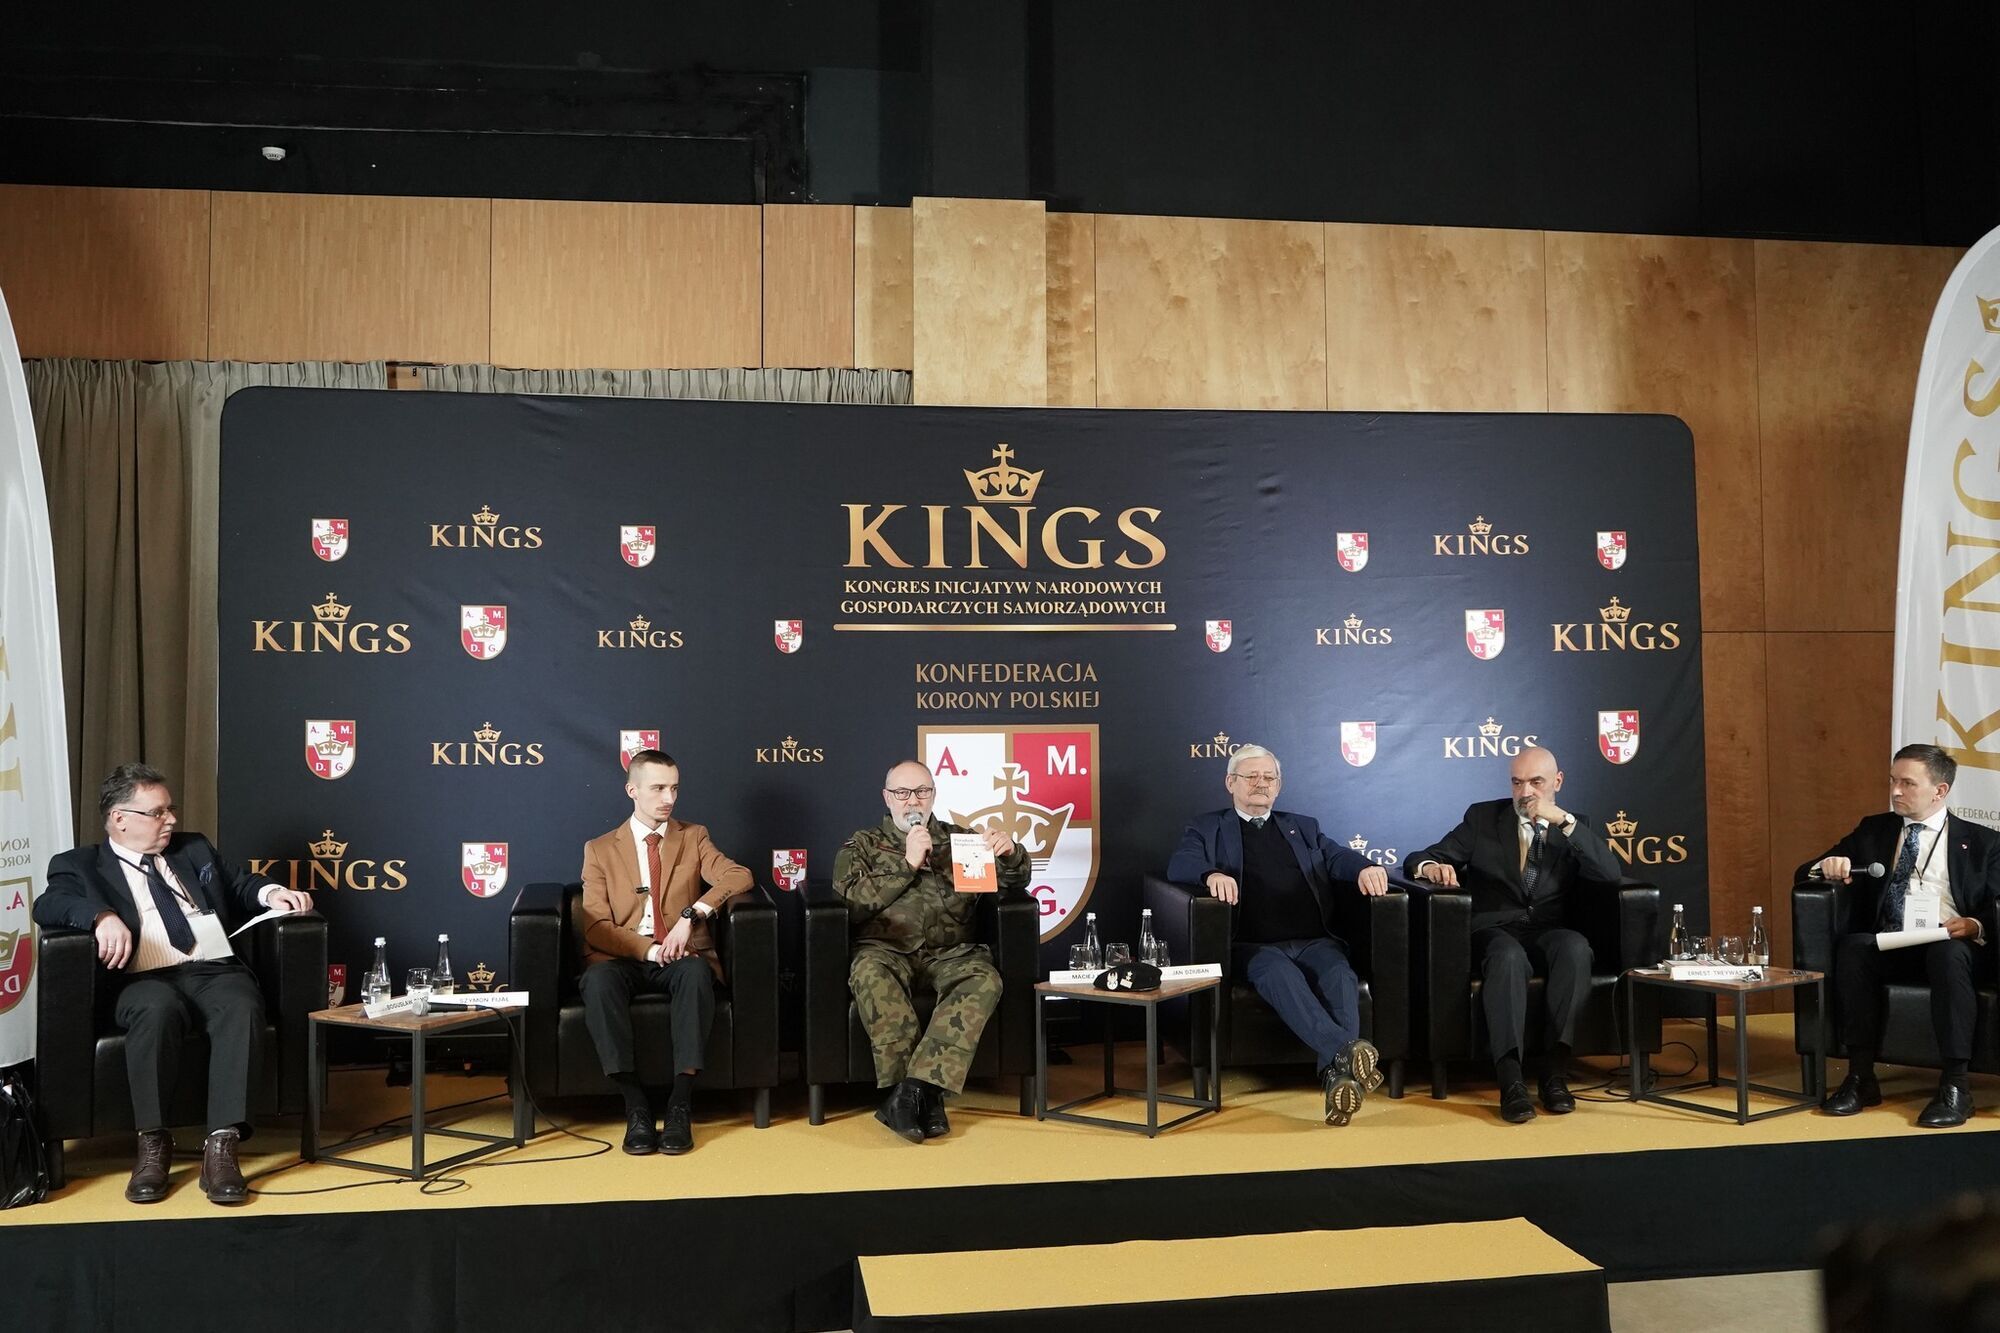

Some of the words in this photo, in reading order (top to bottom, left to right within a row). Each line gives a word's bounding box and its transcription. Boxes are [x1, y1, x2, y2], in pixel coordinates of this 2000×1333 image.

[429, 524, 543, 549] KINGS
[840, 503, 1167, 569] KINGS
[1433, 534, 1530, 557] KINGS
[844, 580, 930, 594] KONGRES
[935, 581, 1032, 594] INICJATYW
[1035, 581, 1162, 594] NARODOWYCH
[840, 600, 998, 615] GOSPODARCZYCH
[1003, 600, 1166, 618] SAMORZĄDOWYCH
[251, 620, 412, 654] KINGS
[597, 630, 684, 648] KINGS
[1315, 628, 1393, 646] KINGS
[1552, 622, 1681, 653] KINGS
[916, 663, 1098, 683] KONFEDERACJA
[916, 692, 1002, 709] KORONY
[1010, 691, 1100, 709] POLSKIEJ
[340, 725, 352, 734] M.
[431, 742, 545, 766] KINGS
[756, 748, 824, 763] KINGS
[1190, 743, 1252, 758] KING
[1443, 735, 1538, 759] KINGS
[315, 763, 326, 771] D.
[935, 746, 968, 776] A.
[1047, 745, 1087, 776] M.
[493, 848, 505, 856] M.
[1606, 835, 1688, 865] NGS
[248, 859, 408, 891] KINGS
[471, 882, 481, 890] D.
[1031, 885, 1067, 915] G.
